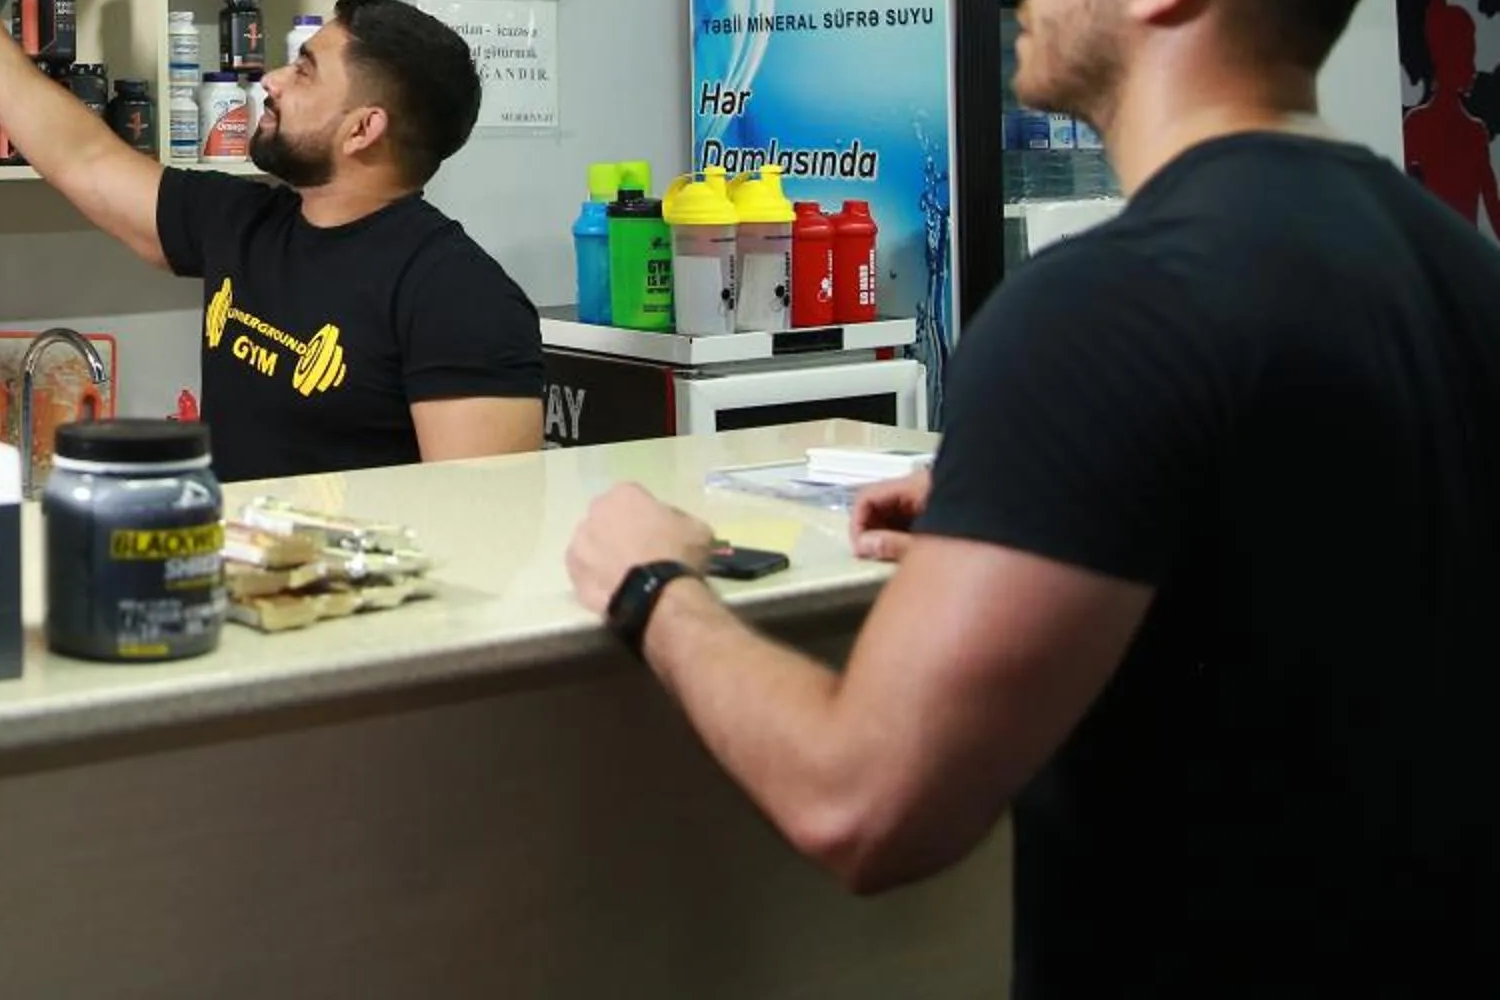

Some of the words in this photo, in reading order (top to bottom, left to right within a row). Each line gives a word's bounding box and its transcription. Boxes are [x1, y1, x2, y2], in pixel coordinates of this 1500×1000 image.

[747, 10, 818, 33] MİNERAL
[885, 7, 934, 26] SUYU
[228, 307, 307, 355] UNDERGROUND
[232, 335, 279, 377] GYM
